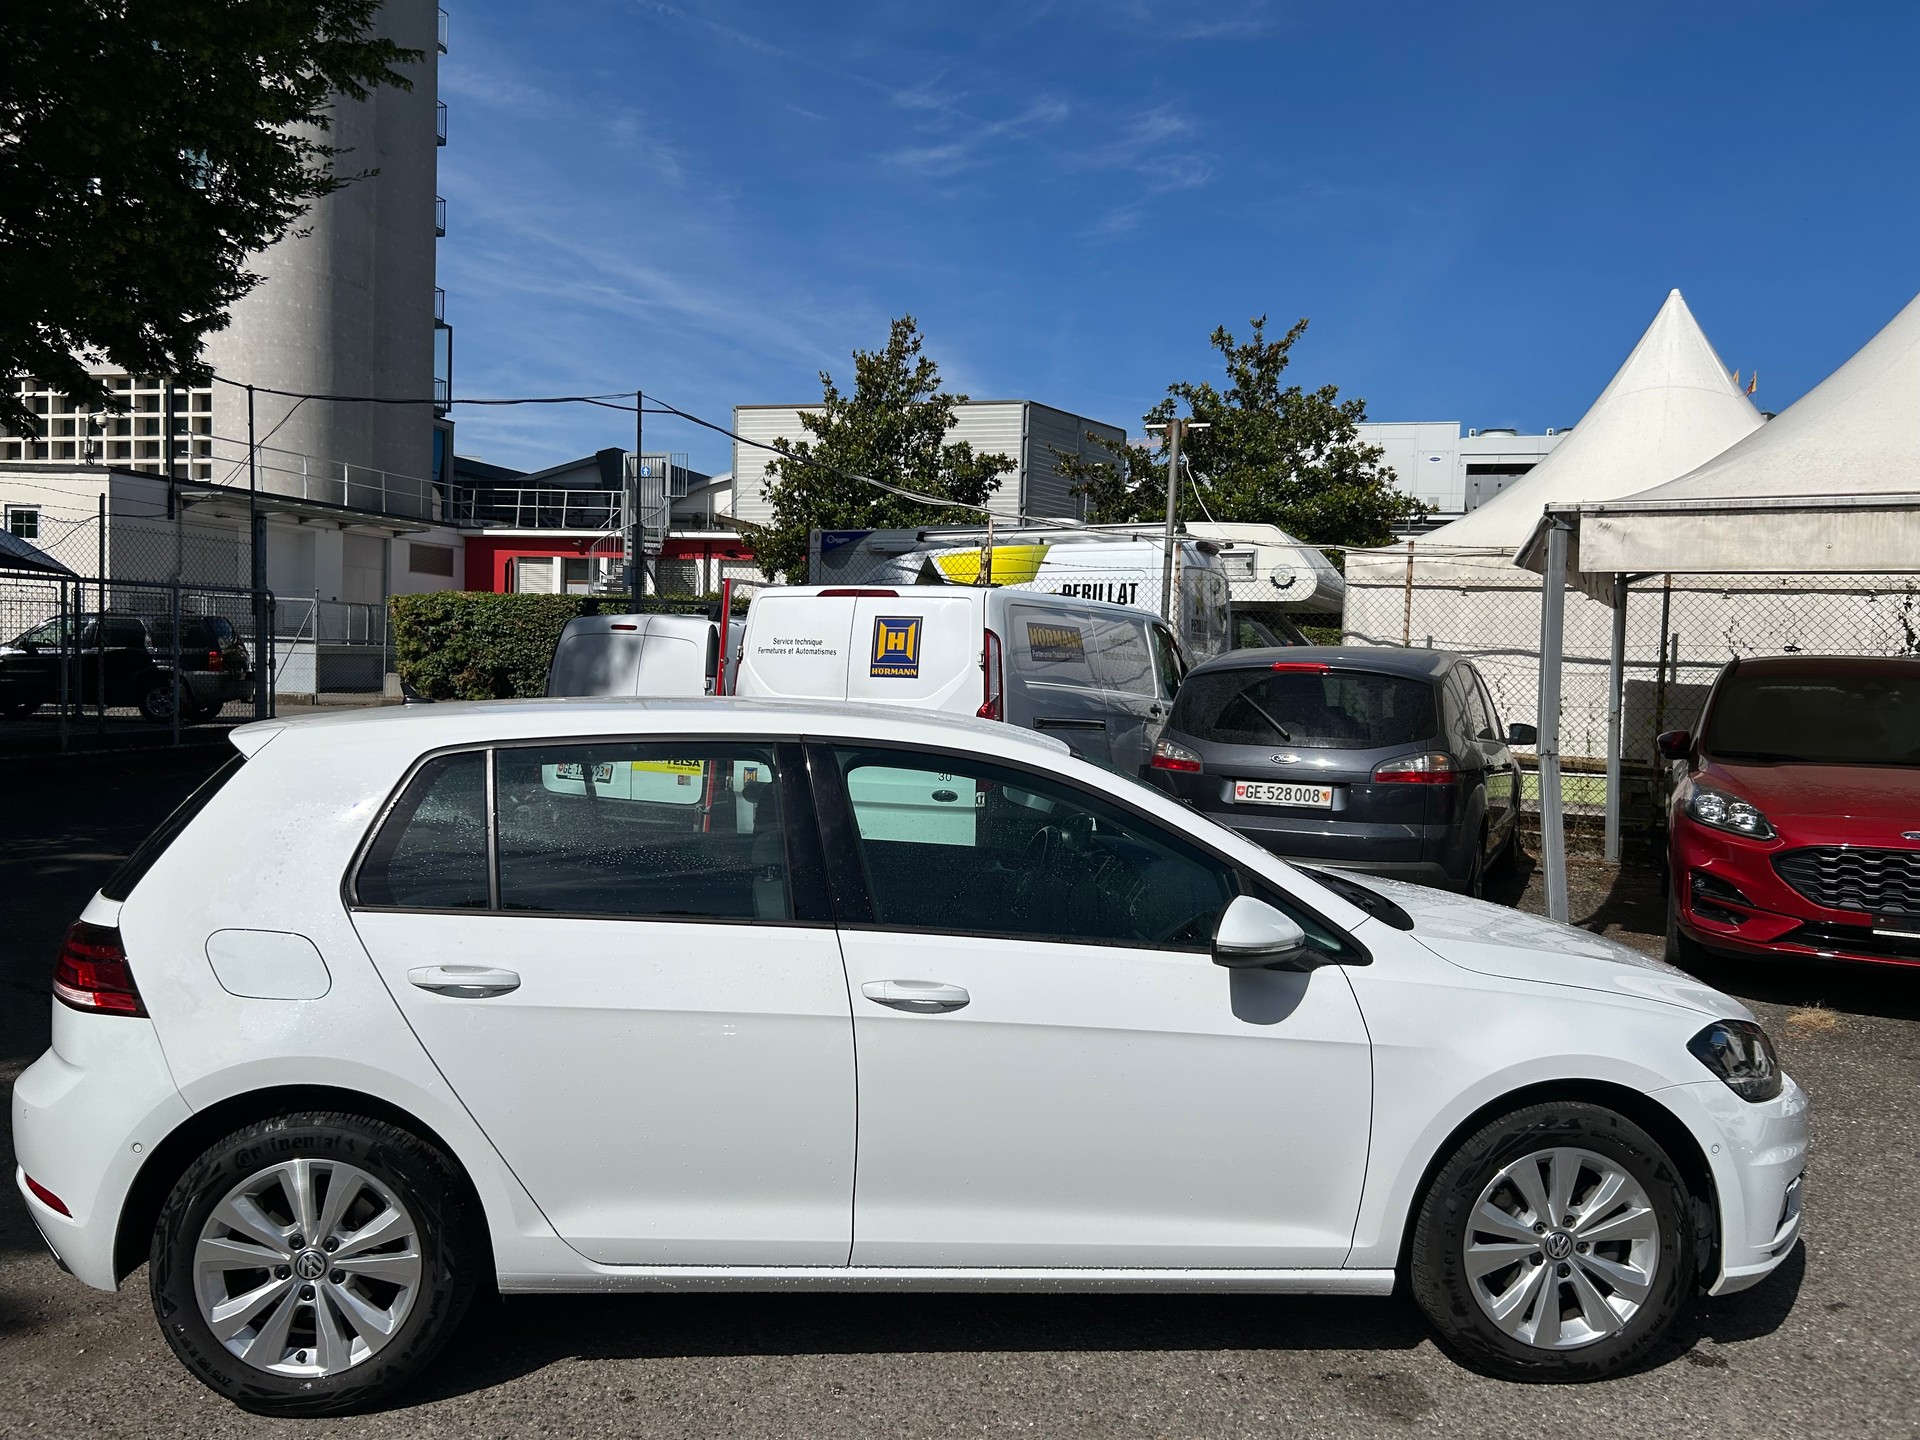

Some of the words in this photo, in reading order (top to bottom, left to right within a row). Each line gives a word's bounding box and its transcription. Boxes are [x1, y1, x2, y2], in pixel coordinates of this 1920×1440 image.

[773, 637, 793, 645] Service
[795, 638, 822, 647] technique
[796, 647, 837, 656] Automatismes
[871, 667, 917, 676] HÖRMANN
